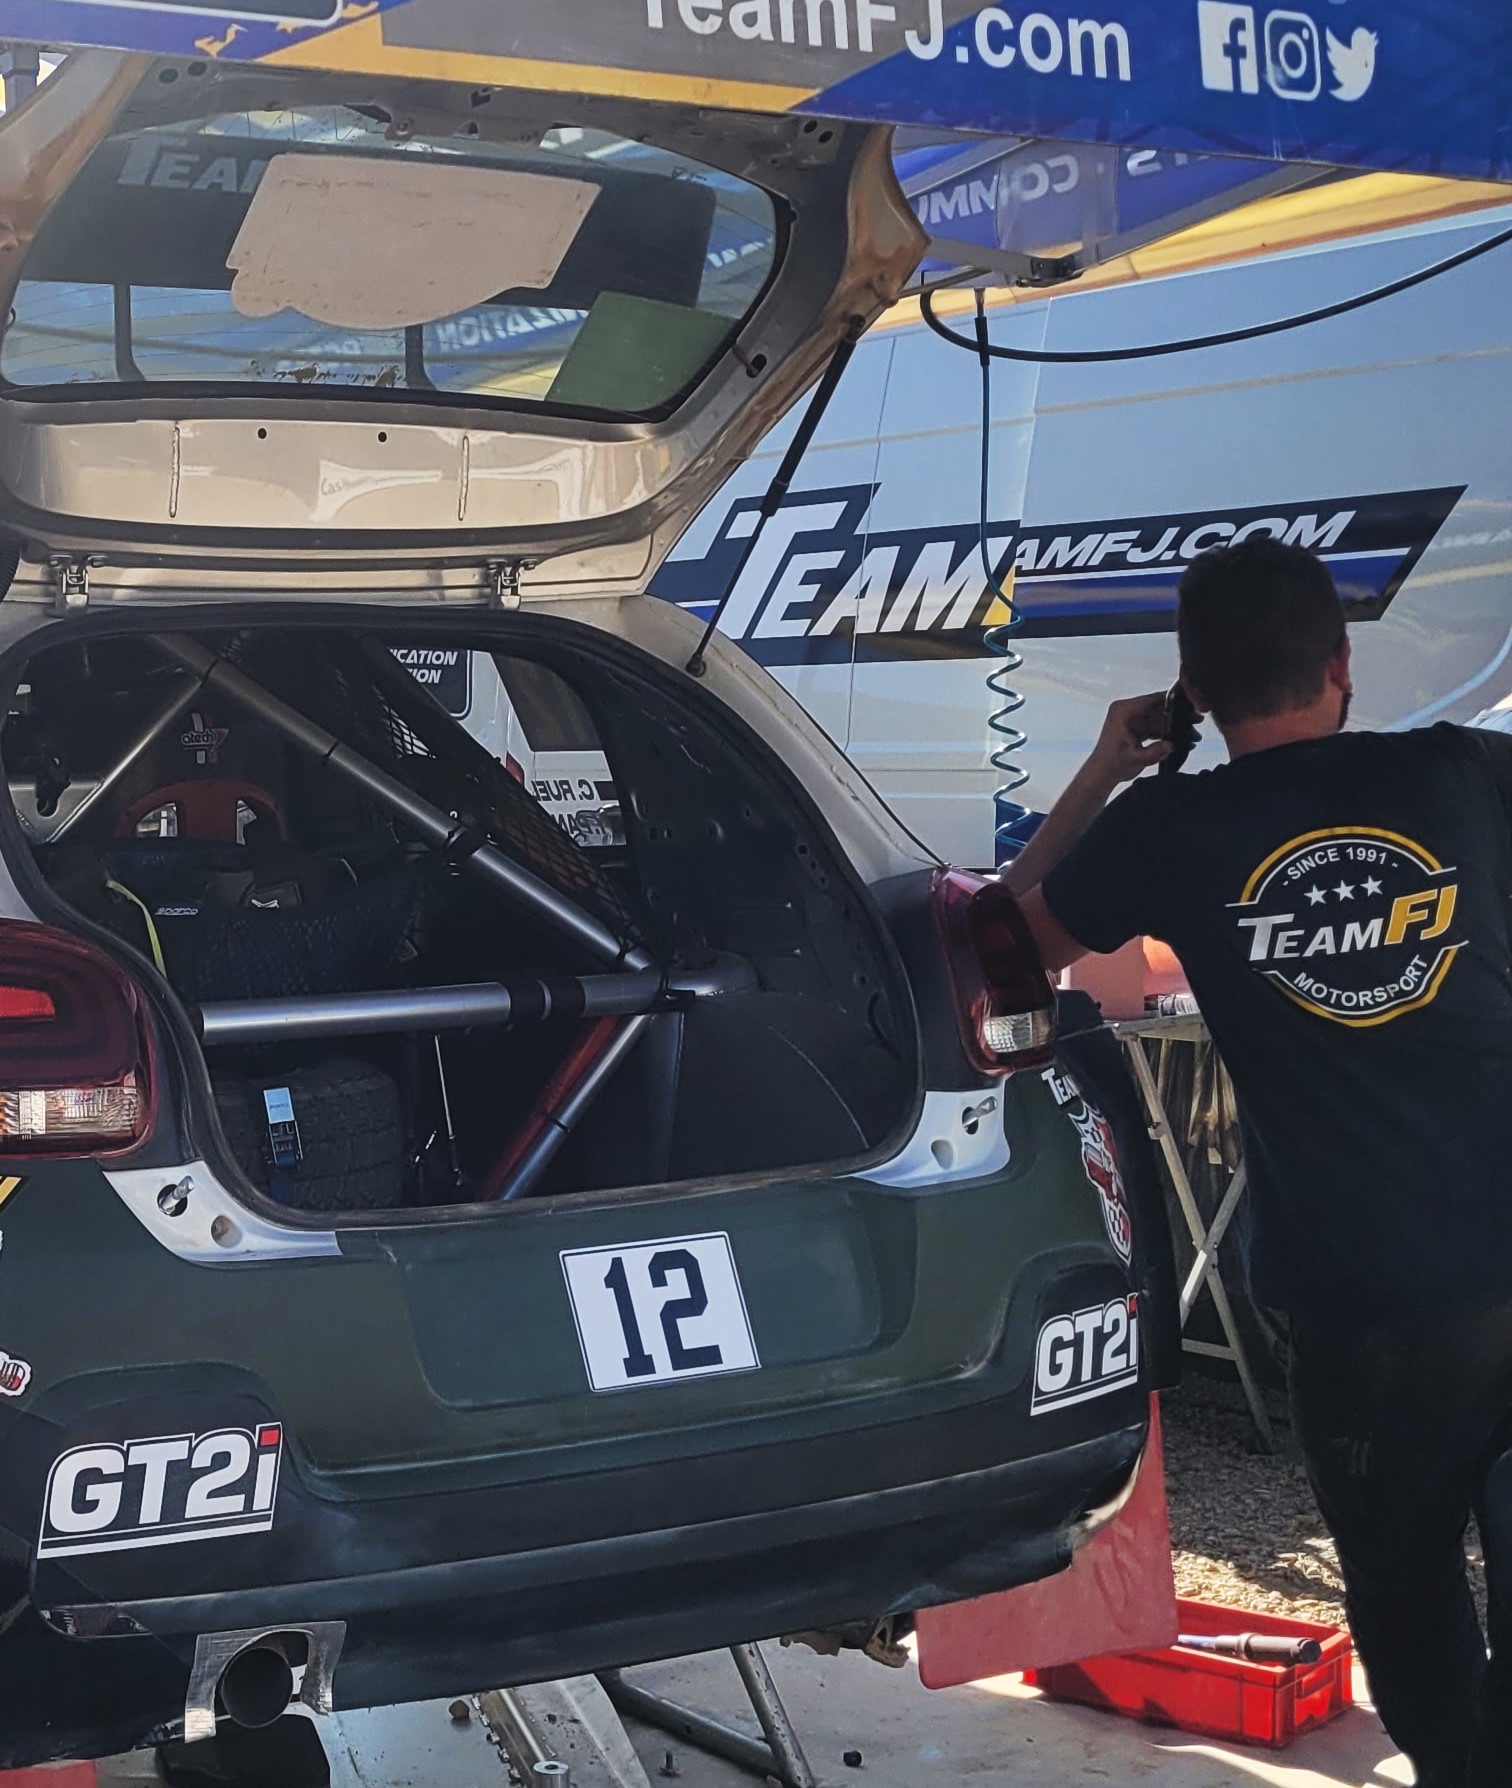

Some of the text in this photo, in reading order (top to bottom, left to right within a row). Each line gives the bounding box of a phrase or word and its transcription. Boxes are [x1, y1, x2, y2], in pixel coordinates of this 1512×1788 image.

[1288, 847, 1388, 881] SINCE 1991
[1294, 954, 1428, 1007] MOTORSPORT
[603, 1248, 724, 1379] 12
[1037, 1298, 1139, 1393] GT2i
[48, 1429, 282, 1534] GT2i
